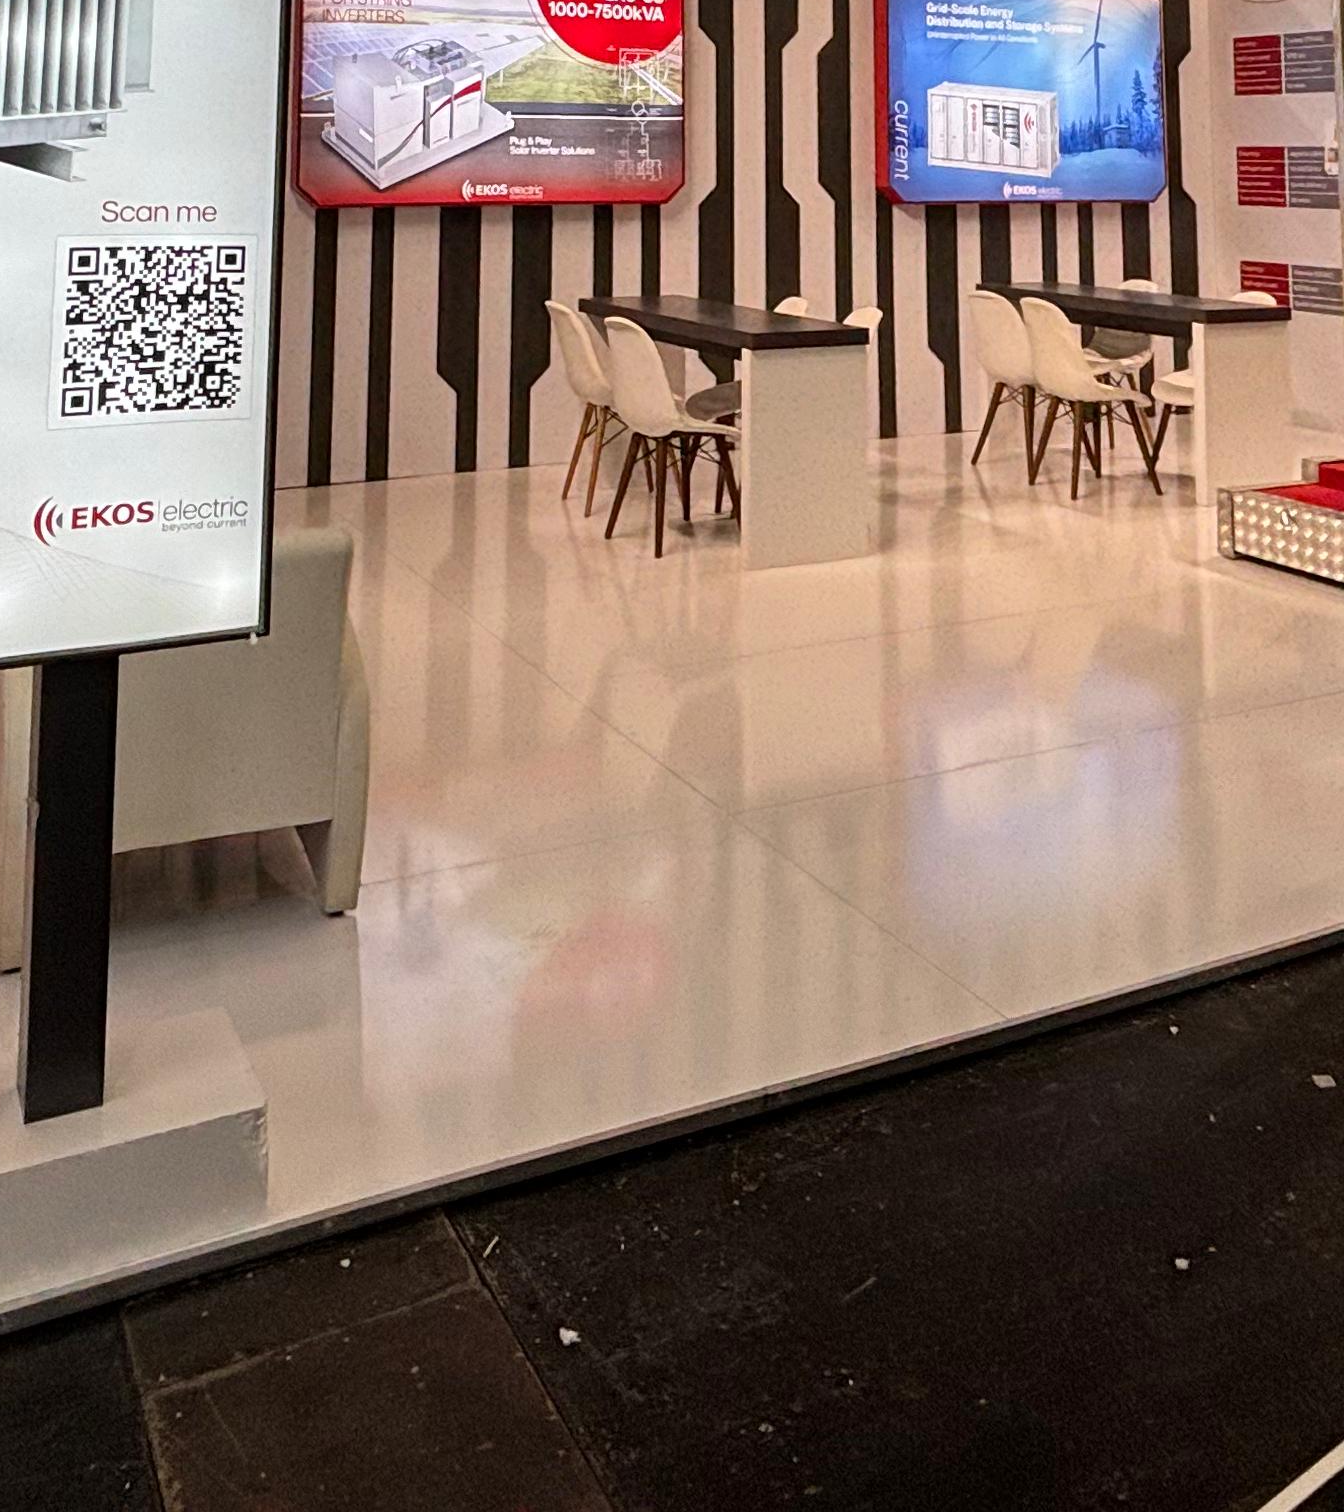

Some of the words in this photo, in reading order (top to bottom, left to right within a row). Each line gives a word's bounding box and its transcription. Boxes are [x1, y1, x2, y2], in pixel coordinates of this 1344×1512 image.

[323, 8, 405, 24] INVERTERS
[548, 1, 664, 22] 1000-7500kVA
[981, 5, 1013, 20] Energy
[926, 15, 983, 29] Distribution
[985, 19, 1004, 29] and
[894, 100, 910, 181] current
[476, 184, 508, 196] EKOS
[102, 200, 169, 223] Scan
[176, 205, 217, 223] me
[71, 500, 154, 529] EKOS
[163, 496, 248, 521] electric
[162, 520, 203, 532] beyond
[207, 518, 246, 528] current
